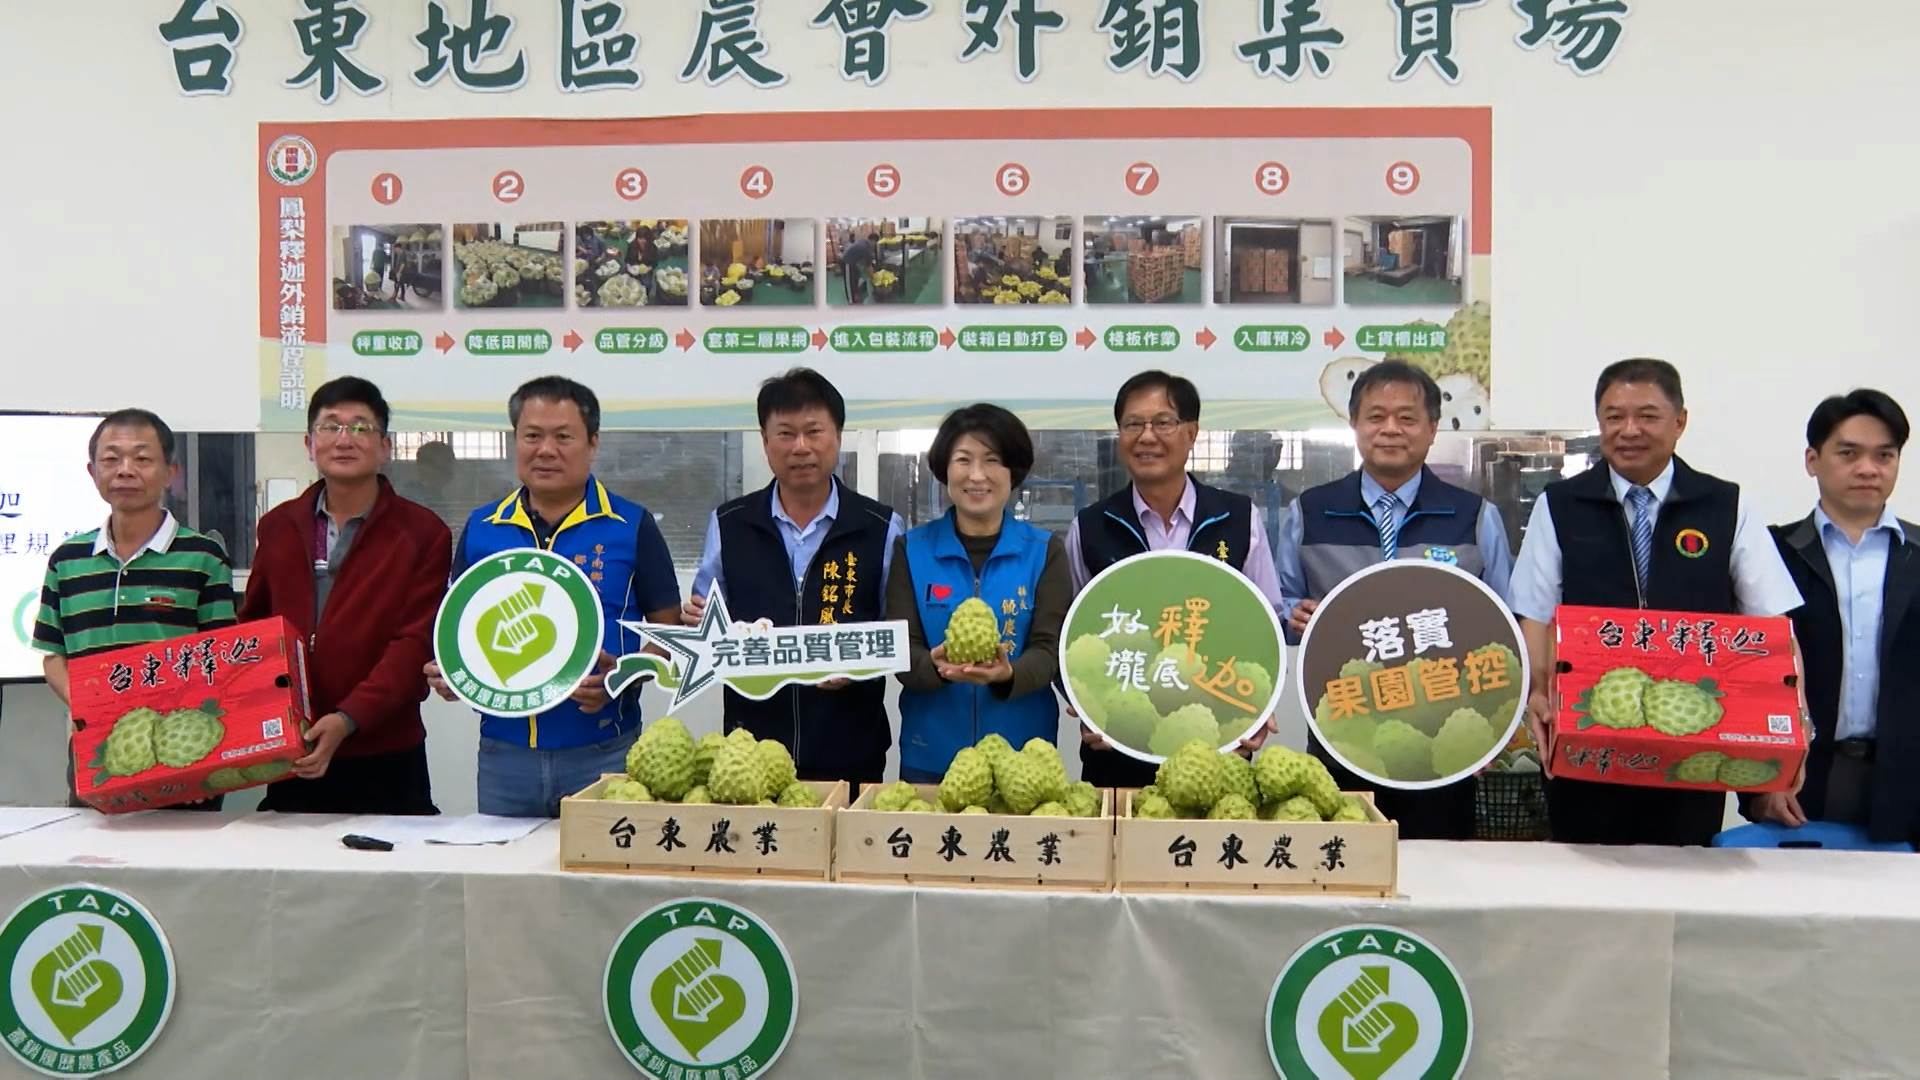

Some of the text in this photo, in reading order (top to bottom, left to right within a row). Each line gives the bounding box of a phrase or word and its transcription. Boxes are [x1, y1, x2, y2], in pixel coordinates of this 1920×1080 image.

[600, 333, 666, 349] 品管分級
[833, 331, 935, 347] 進入包裝流程
[962, 331, 1064, 347] 裝箱自動打包
[1239, 330, 1307, 347] 入庫預冷
[498, 555, 572, 580] TAP
[1358, 607, 1453, 662] 落實
[711, 629, 897, 668] 完善品質管理
[1325, 648, 1511, 722] 果園管控
[609, 815, 780, 856] 台東農業
[887, 824, 1063, 867] 台東農業
[1168, 832, 1347, 873] 台東農業
[48, 893, 131, 918] TAP
[661, 907, 750, 931] TAP
[1323, 933, 1417, 956] TAP
